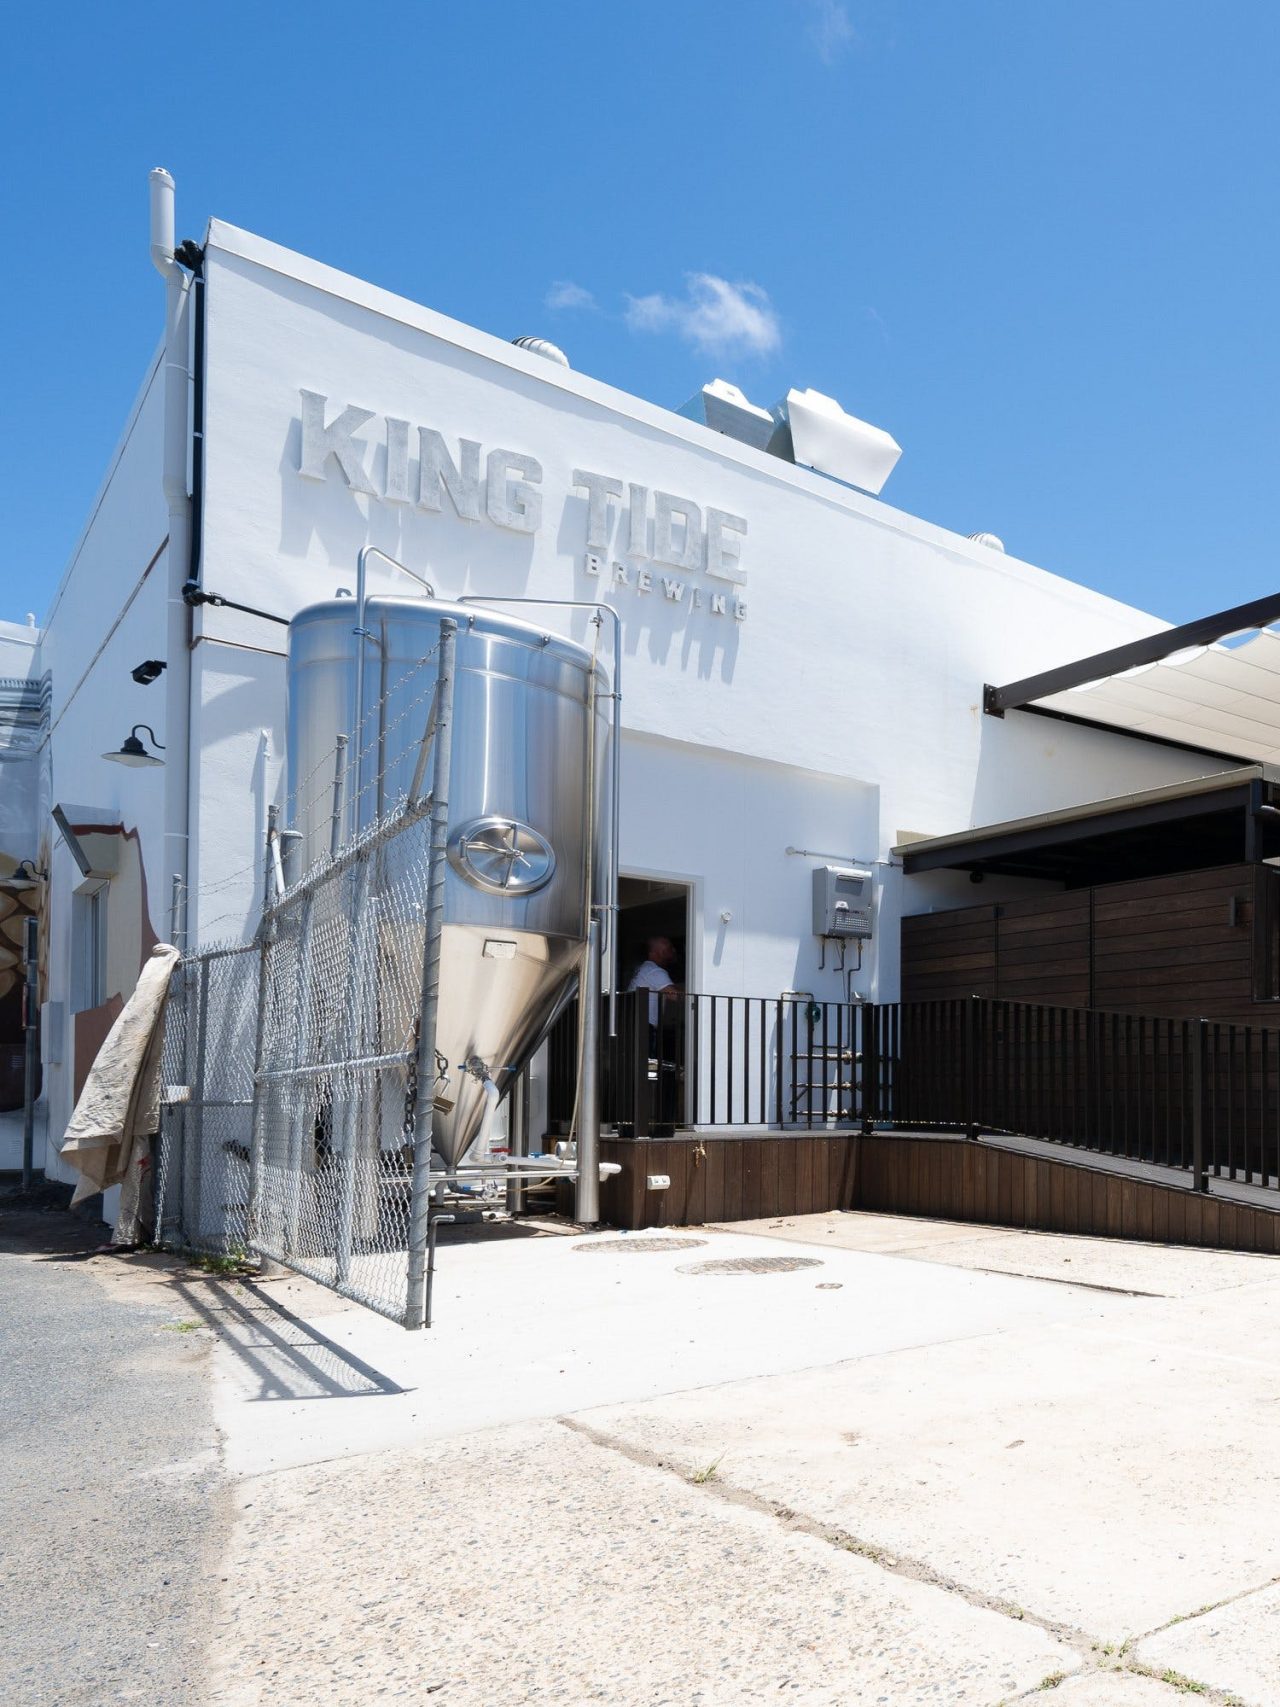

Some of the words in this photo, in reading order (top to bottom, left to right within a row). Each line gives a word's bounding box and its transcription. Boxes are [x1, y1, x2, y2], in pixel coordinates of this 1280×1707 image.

[298, 388, 542, 535] KING
[573, 468, 748, 586] TIDE
[584, 553, 748, 622] BREWING
